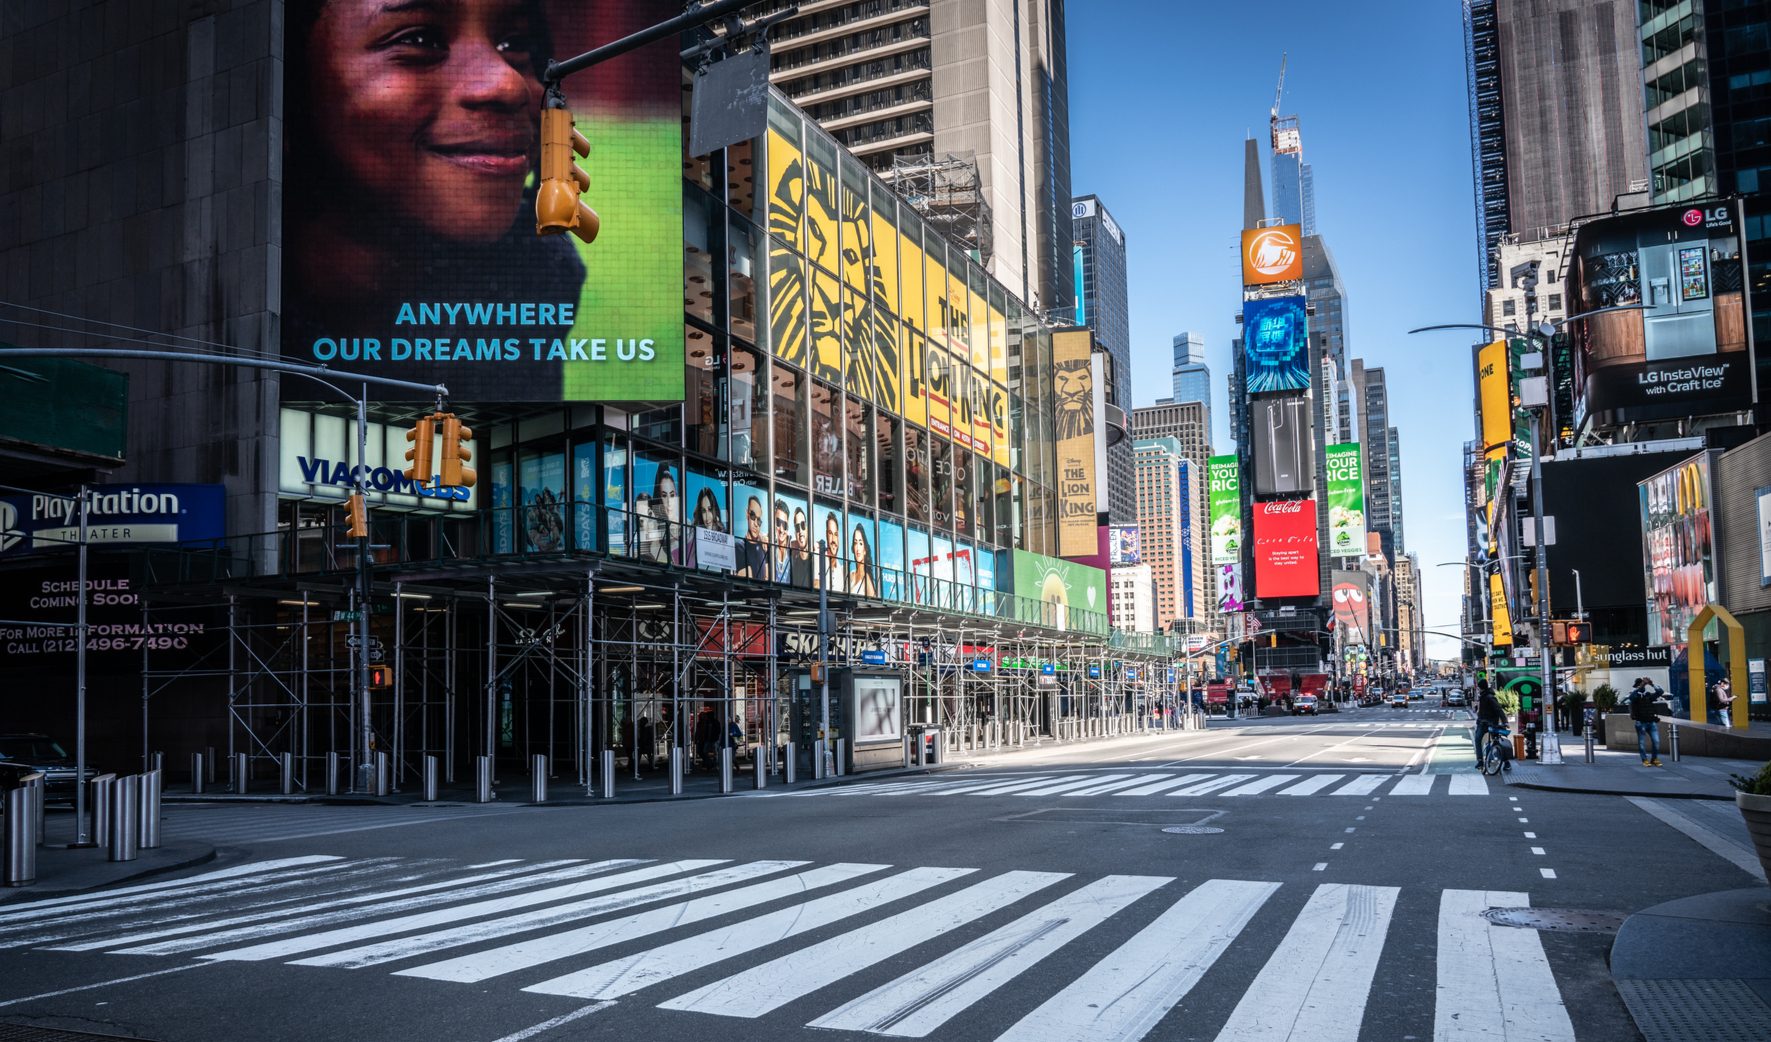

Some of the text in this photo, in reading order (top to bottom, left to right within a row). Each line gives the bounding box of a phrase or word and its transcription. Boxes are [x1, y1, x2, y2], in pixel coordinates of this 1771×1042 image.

[1705, 207, 1727, 222] LG
[394, 303, 574, 325] ANYWHERE
[938, 295, 969, 346] THE
[313, 338, 655, 361] OUR DREAMS TAKE US
[908, 317, 1004, 430] LION KING
[1639, 372, 1658, 384] LG
[1646, 386, 1666, 394] with
[1667, 380, 1700, 392] Craft
[931, 418, 950, 433] ENTRANCE
[954, 430, 960, 438] ON
[1064, 468, 1084, 478] THE
[1327, 468, 1358, 482] RICE
[1061, 481, 1089, 497] LION
[1212, 479, 1238, 492] RIC
[1179, 467, 1190, 522] NOVOTEL
[1060, 499, 1094, 518] KING
[1264, 500, 1304, 514] Coca-Cola
[61, 528, 131, 540] THATER
[41, 579, 130, 593] SCHEDULE
[0, 628, 24, 640] FOR
[26, 626, 66, 639] MORE
[7, 642, 40, 654] CALL
[86, 636, 188, 651] 496-7490
[1594, 649, 1668, 664] sunglass hut
